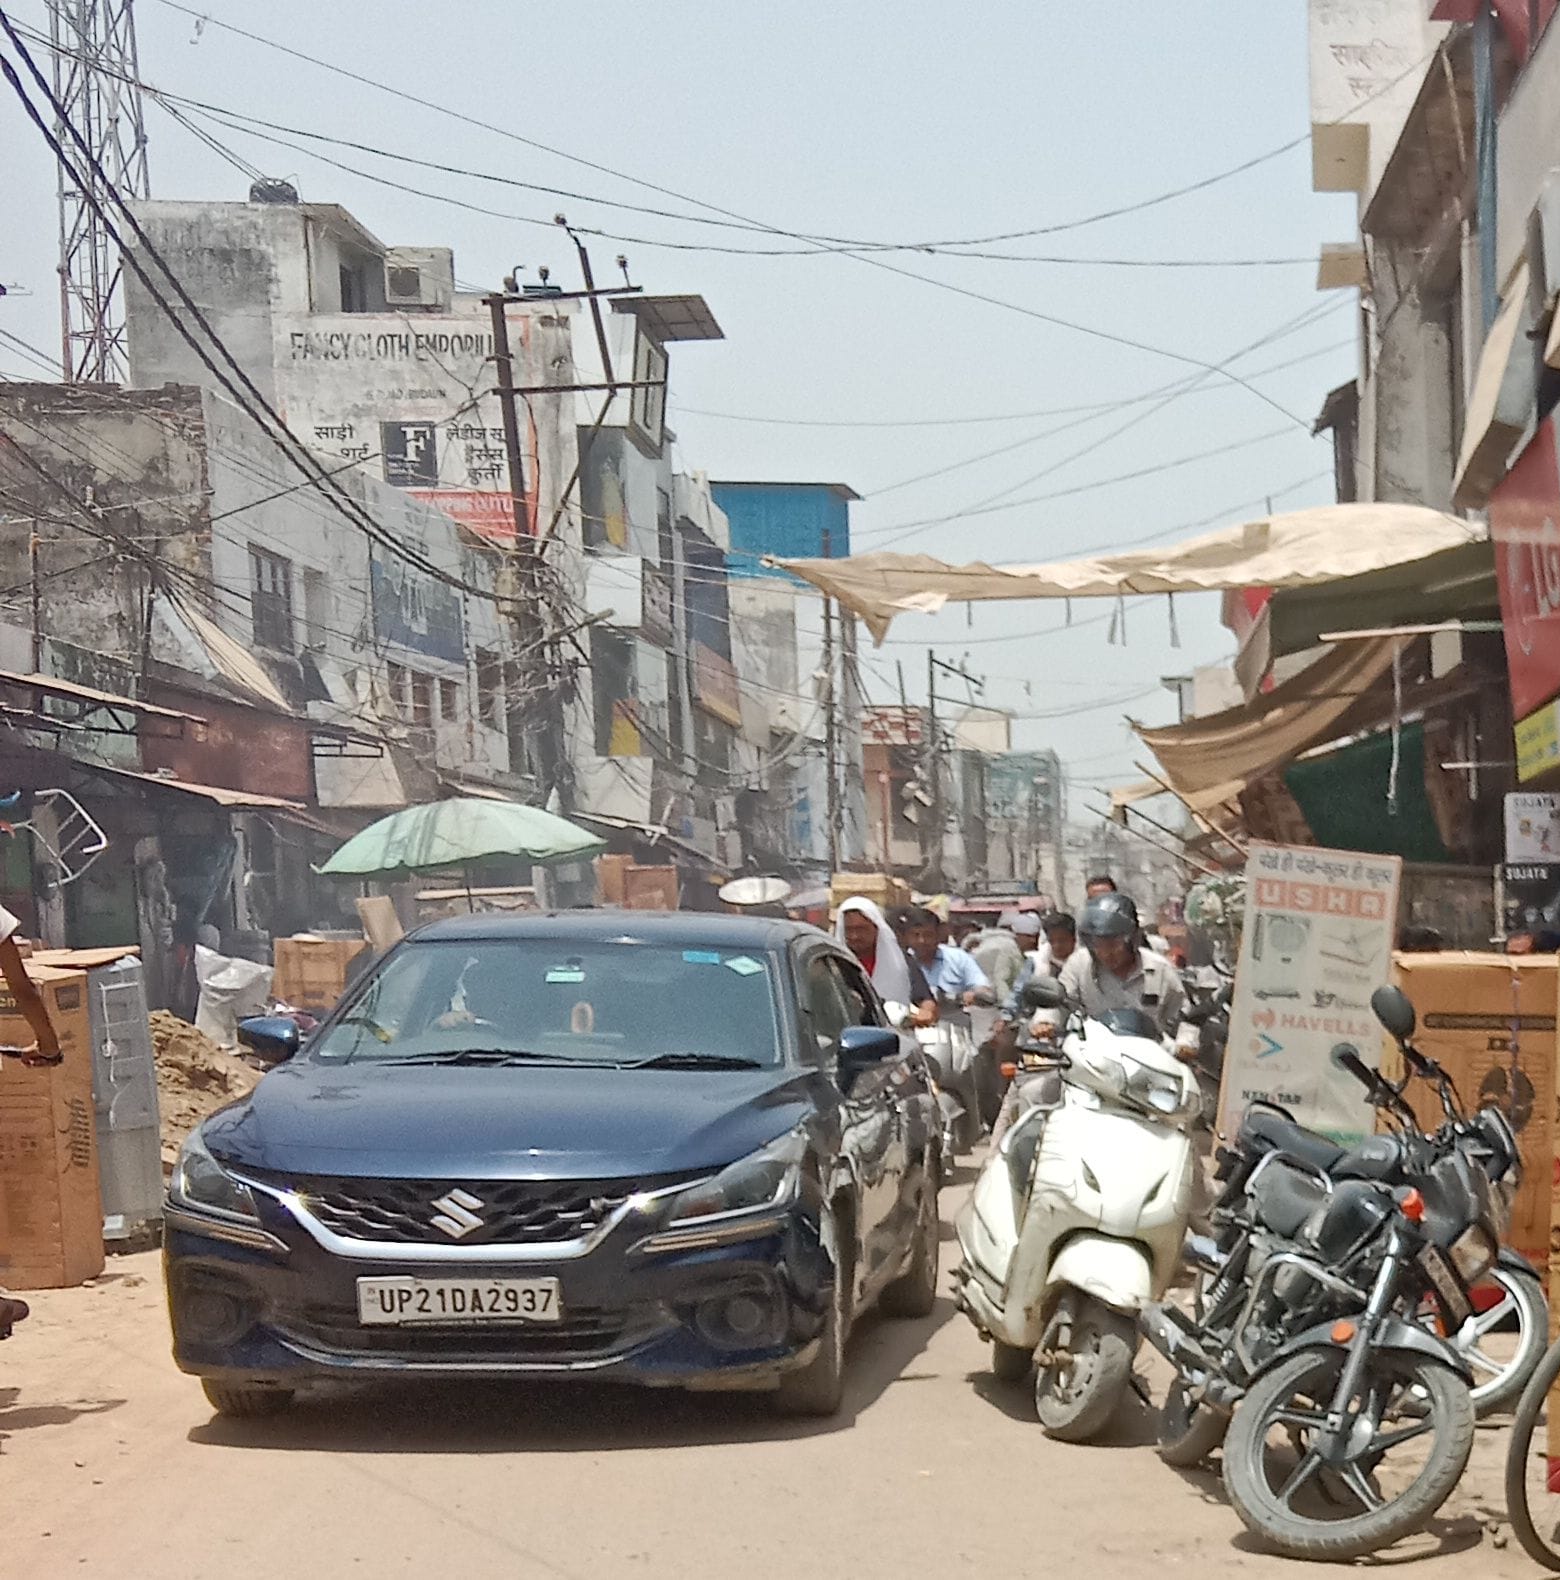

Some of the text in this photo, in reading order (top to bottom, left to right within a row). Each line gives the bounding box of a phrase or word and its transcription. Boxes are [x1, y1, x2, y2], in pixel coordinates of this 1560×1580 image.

[414, 333, 497, 362] EMPORIU
[400, 426, 431, 462] F
[1505, 866, 1549, 881] SUJATA
[1262, 880, 1382, 915] USHA
[1281, 1013, 1370, 1037] HAVELLS
[378, 1287, 554, 1314] UP21DA2937
